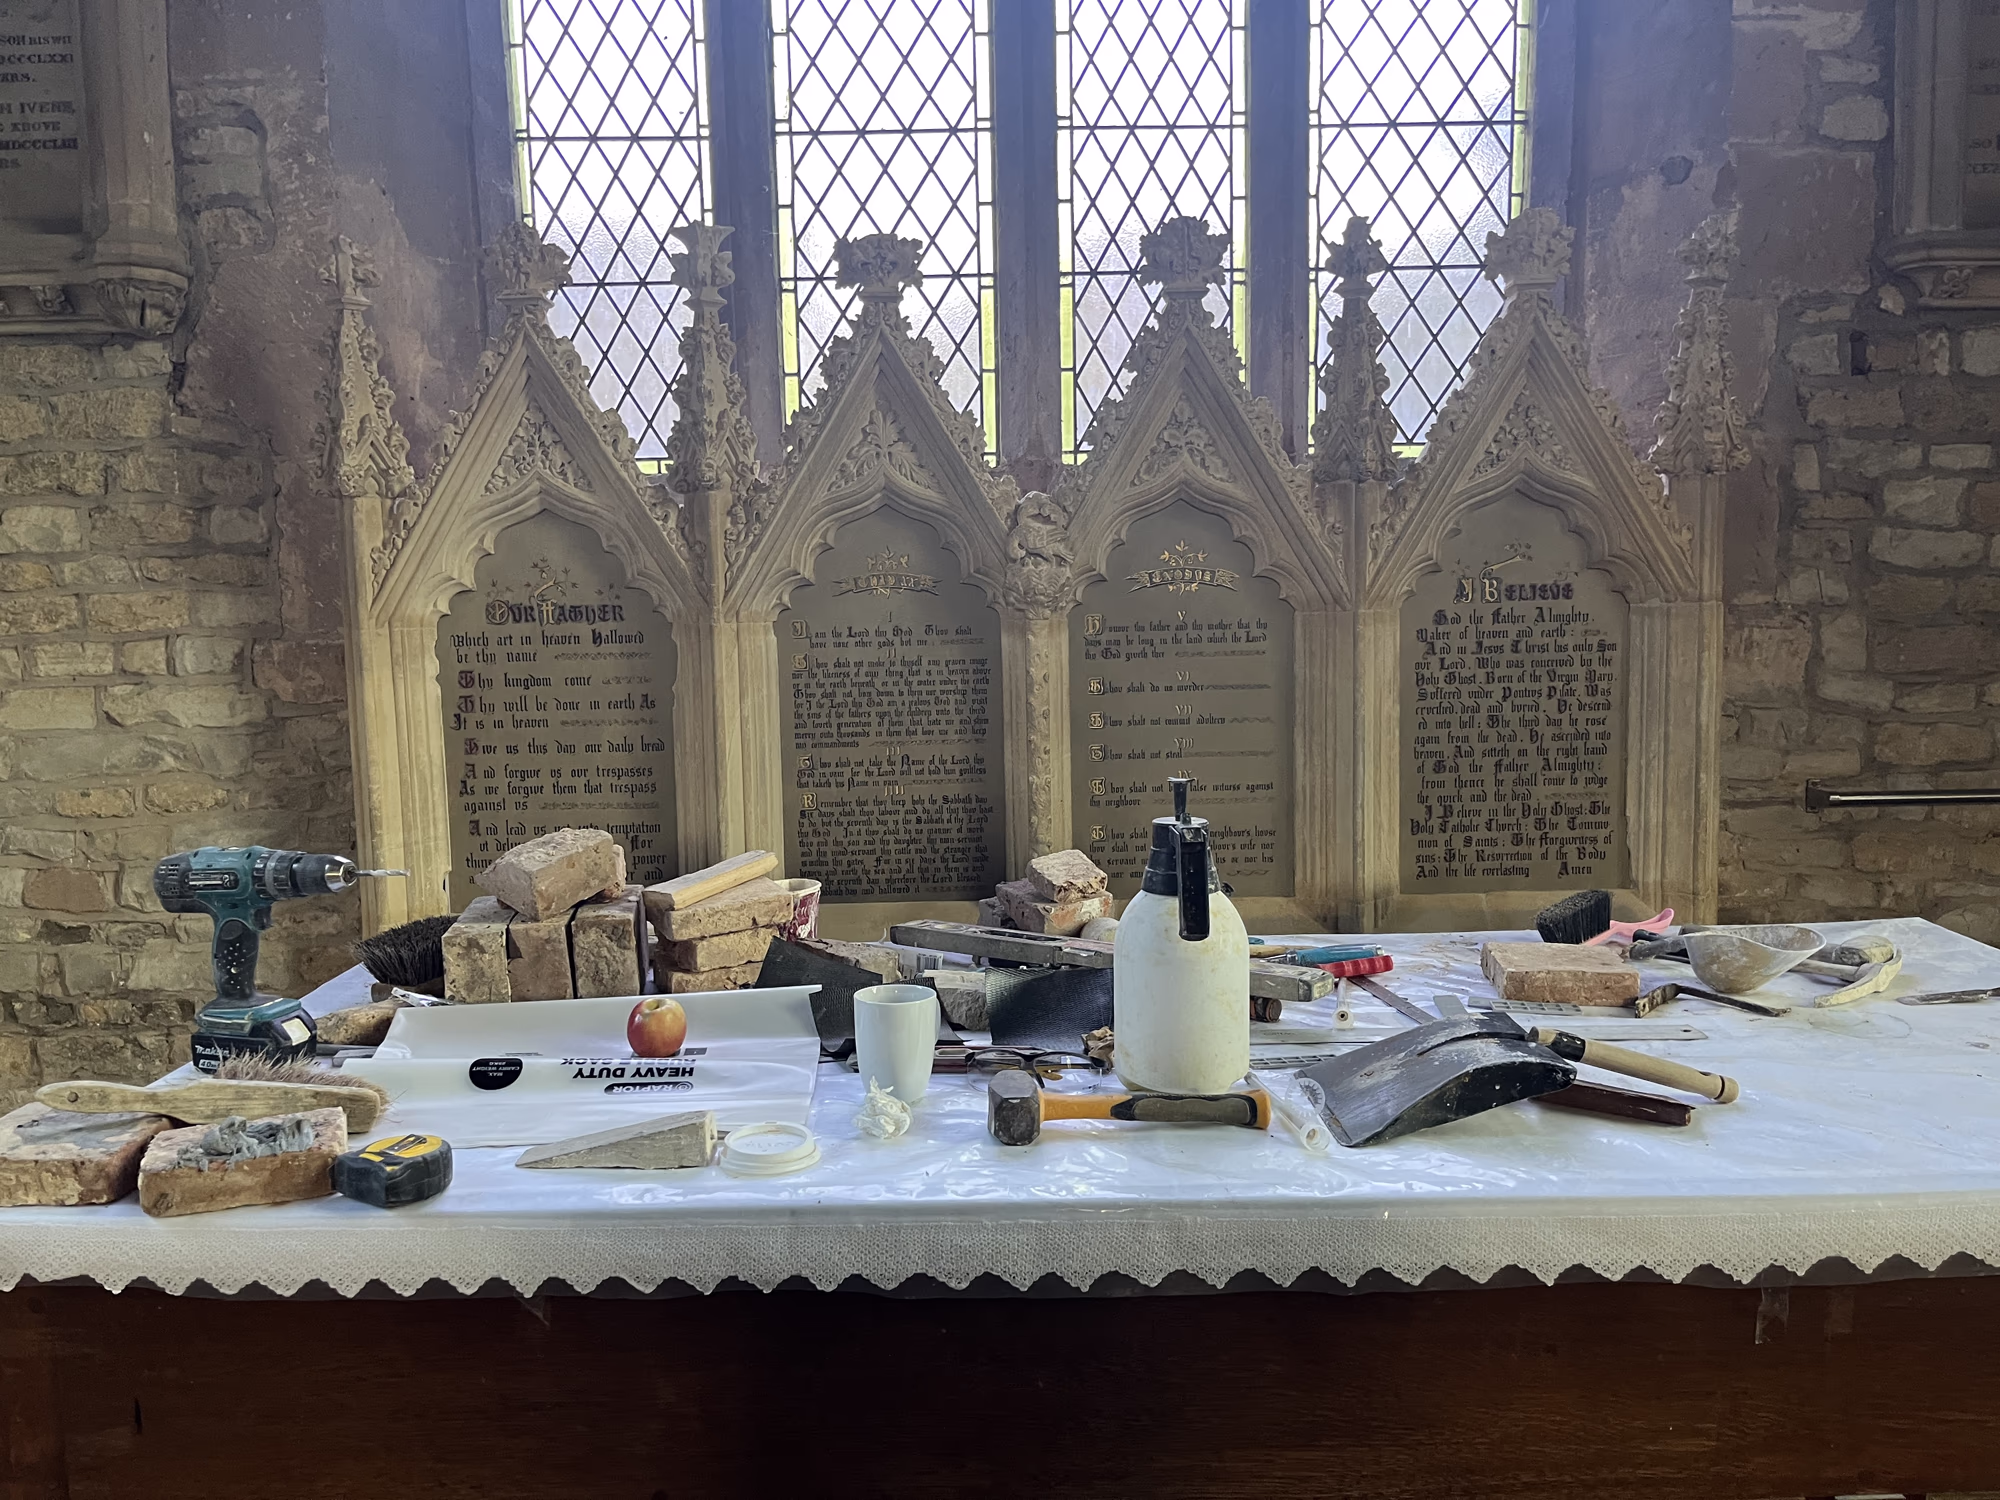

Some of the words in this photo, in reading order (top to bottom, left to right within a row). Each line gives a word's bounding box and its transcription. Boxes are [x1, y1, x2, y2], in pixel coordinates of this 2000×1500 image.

[1175, 619, 1188, 631] and
[1432, 609, 1461, 626] God
[1469, 609, 1483, 625] the
[451, 631, 489, 649] Which
[497, 633, 513, 646] art
[520, 635, 531, 645] in
[542, 630, 581, 647] heaven
[591, 628, 644, 647] Hallowed
[1416, 626, 1451, 642] Maker
[1459, 625, 1469, 640] of
[1475, 626, 1509, 640] heaven
[1516, 626, 1533, 639] and
[878, 637, 894, 649] gods
[1422, 641, 1451, 660] And
[1457, 643, 1466, 655] in
[1554, 639, 1569, 653] his
[1573, 639, 1593, 654] only
[1597, 639, 1617, 653] Son
[457, 649, 469, 664] be
[476, 649, 497, 666] thy
[507, 650, 537, 663] name
[458, 670, 493, 691] Thy
[504, 672, 552, 689] kingdom
[565, 675, 591, 686] come
[1485, 670, 1513, 685] Born
[1518, 671, 1525, 684] of
[1529, 669, 1542, 683] the
[1150, 682, 1160, 692] do
[457, 694, 495, 714] Thy
[503, 695, 528, 712] will
[536, 695, 548, 711] be
[554, 698, 581, 711] done
[589, 698, 600, 710] in
[608, 693, 635, 711] earth
[475, 716, 485, 729] is
[493, 717, 504, 729] in
[512, 713, 549, 729] heaven
[1435, 717, 1451, 730] into
[1486, 714, 1510, 729] The
[1518, 713, 1540, 728] third
[1546, 713, 1562, 728] day
[1569, 713, 1578, 727] he
[1586, 715, 1607, 726] rose
[528, 737, 548, 754] this
[554, 739, 576, 755] day
[607, 736, 634, 754] daily
[641, 735, 665, 752] bread
[464, 762, 495, 780] And
[504, 764, 541, 781] forgive
[597, 765, 653, 780] trespasses
[484, 784, 499, 795] we
[507, 780, 544, 798] forgive
[552, 780, 576, 795] them
[584, 779, 602, 795] that
[610, 780, 657, 798] trespass
[464, 798, 506, 814] against
[469, 820, 498, 837] And
[506, 820, 526, 835] lead
[607, 822, 661, 839] temptation
[632, 853, 667, 869] power
[645, 867, 663, 880] and
[1416, 865, 1439, 881] And
[1445, 864, 1458, 878] the
[1481, 862, 1530, 878] everlasting
[1557, 862, 1592, 879] Amen
[572, 1067, 626, 1079] DUTY
[630, 1067, 695, 1078] HEAVY
[612, 1084, 673, 1093] RAPTOR
